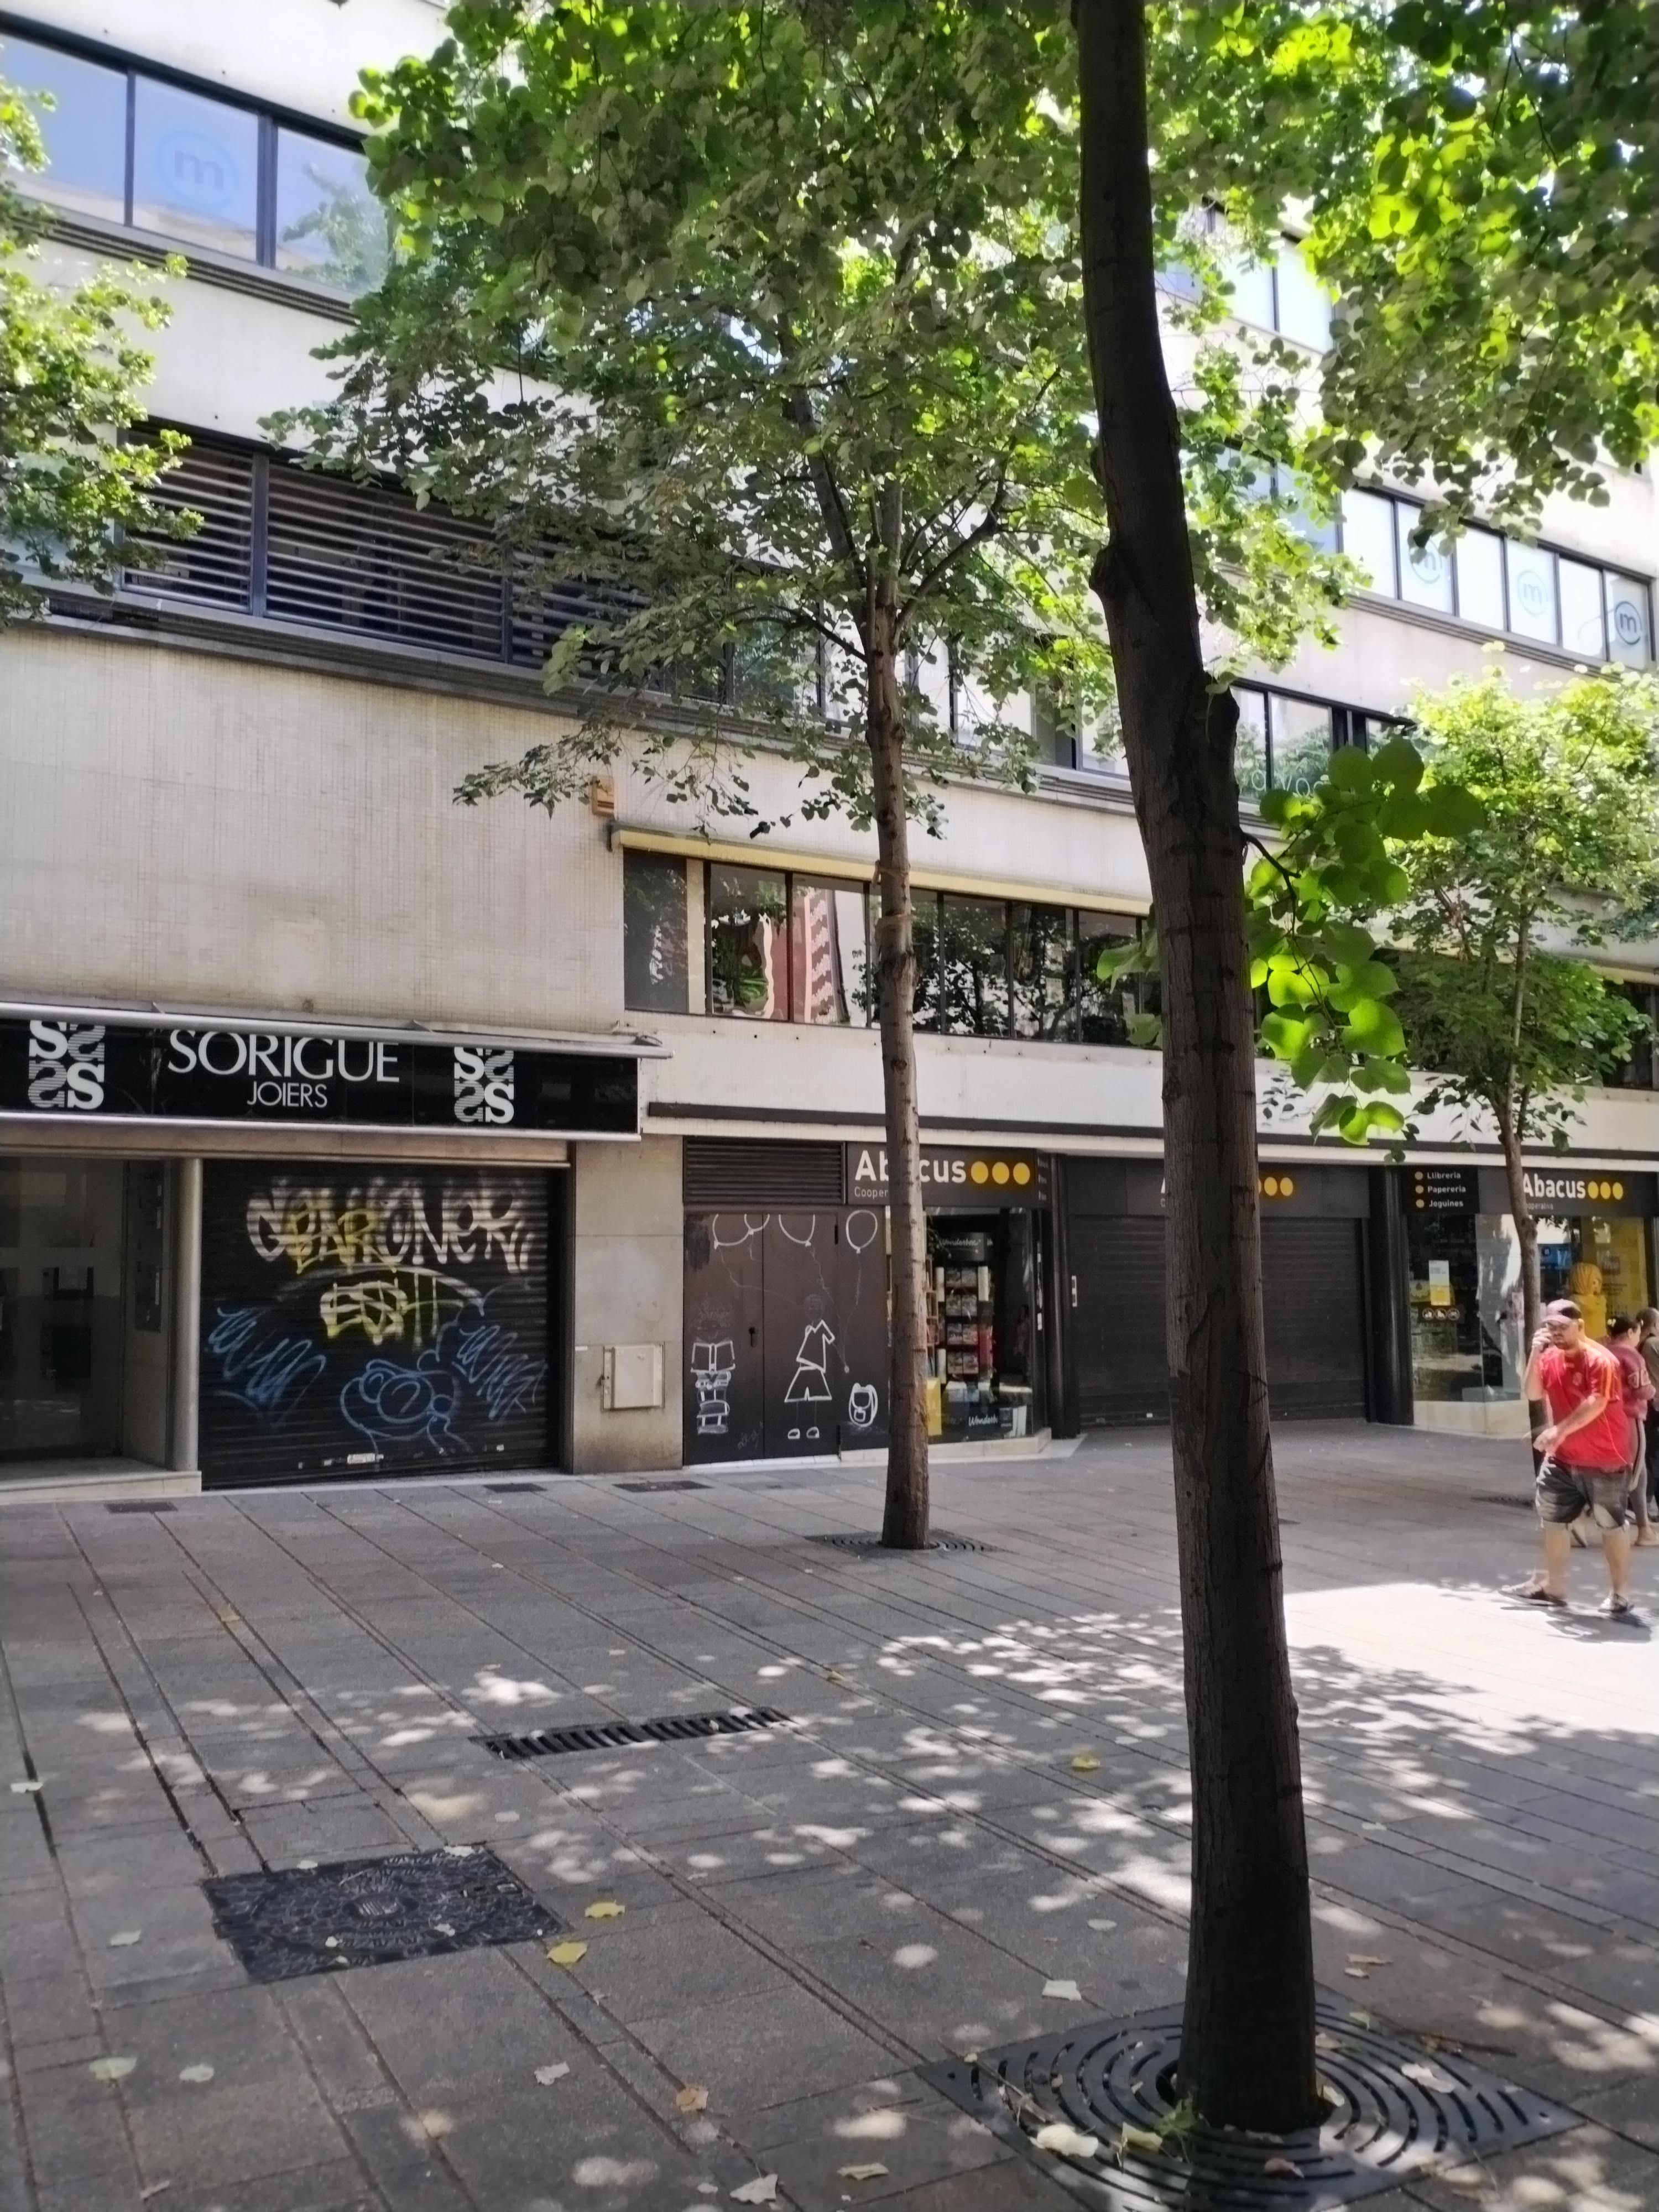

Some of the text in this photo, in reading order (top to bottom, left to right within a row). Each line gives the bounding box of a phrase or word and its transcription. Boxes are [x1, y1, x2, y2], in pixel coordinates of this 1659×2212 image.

[168, 1029, 399, 1082] SORIGUE
[247, 1081, 327, 1108] JOIERS
[854, 1150, 967, 1183] Abcus
[1427, 1171, 1461, 1180] Llibreria
[854, 1186, 889, 1199] Cooper
[1427, 1185, 1467, 1194] Papereria
[1522, 1172, 1587, 1199] Abacus
[1428, 1199, 1464, 1209] Joguines
